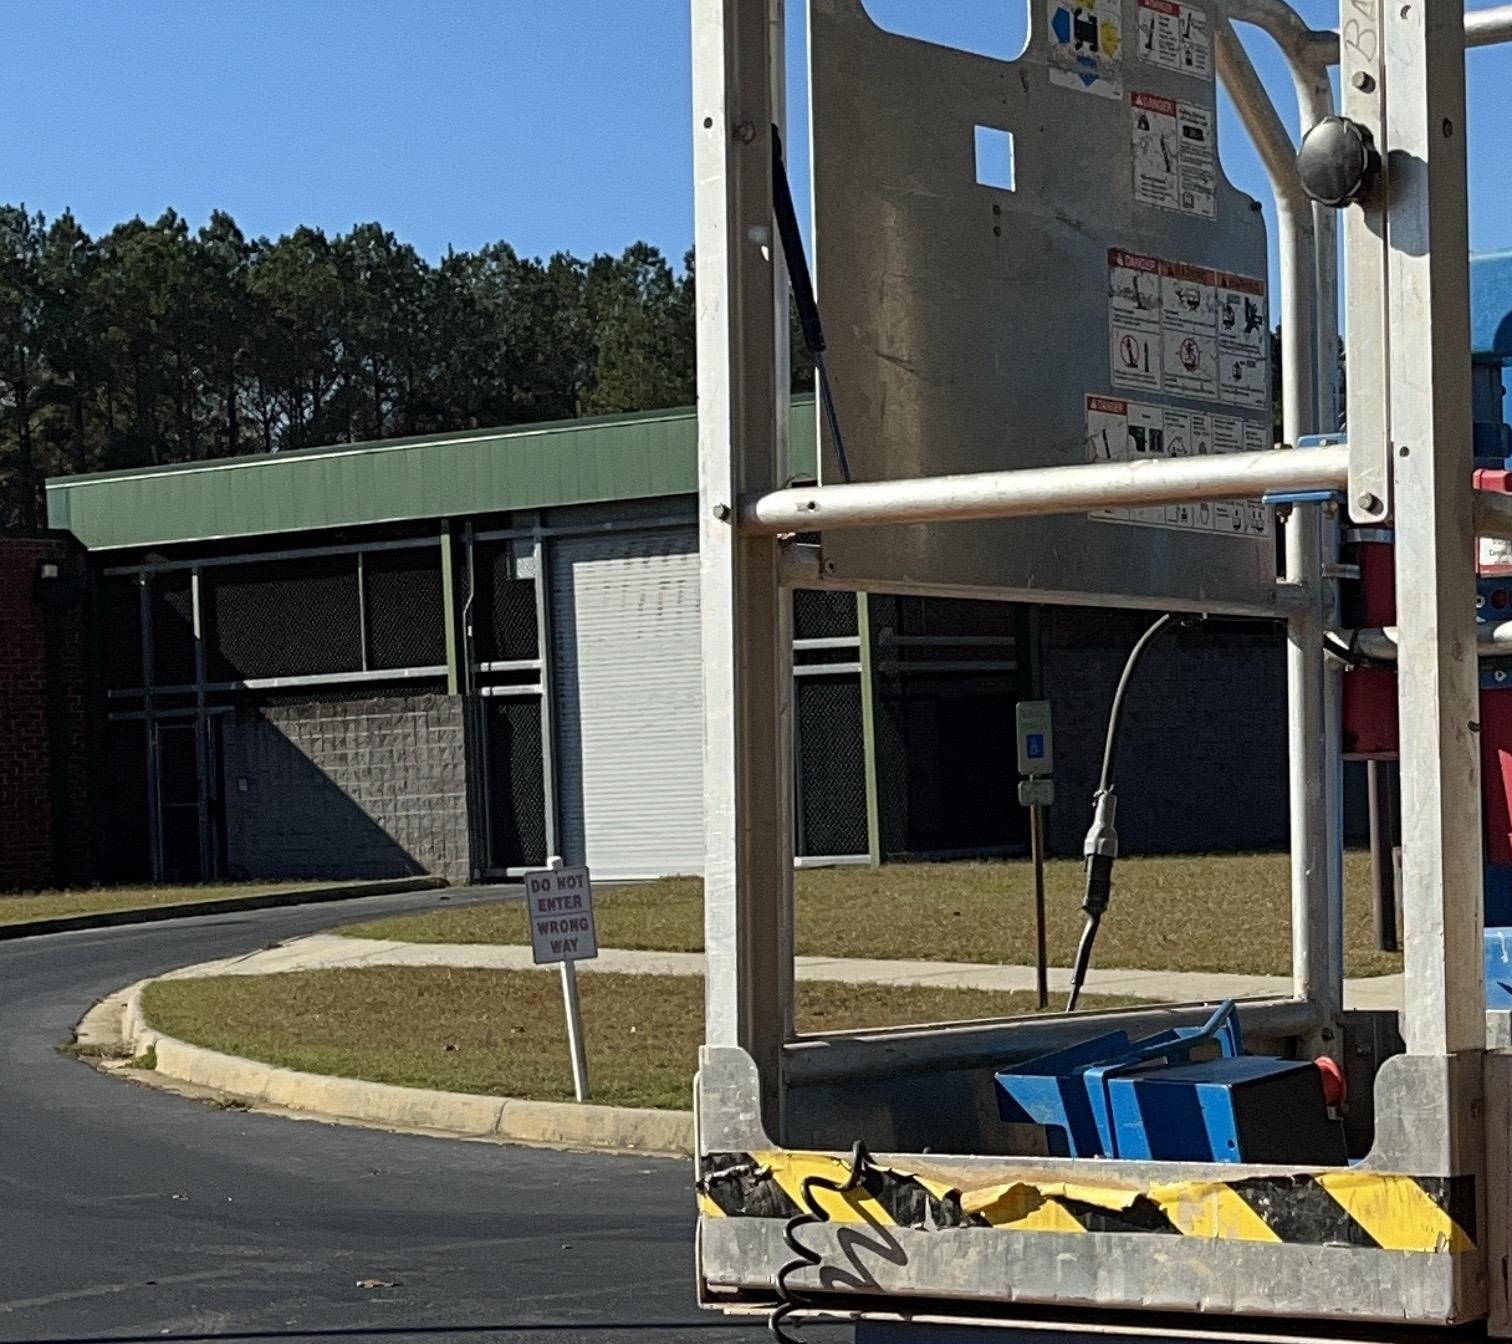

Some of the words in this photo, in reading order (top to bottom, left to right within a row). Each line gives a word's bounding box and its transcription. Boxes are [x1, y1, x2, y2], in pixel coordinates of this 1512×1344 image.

[531, 878, 551, 893] DO
[557, 874, 584, 889] NOT
[538, 894, 583, 912] ENTER
[537, 917, 589, 936] WRONG
[550, 938, 579, 954] WAY
